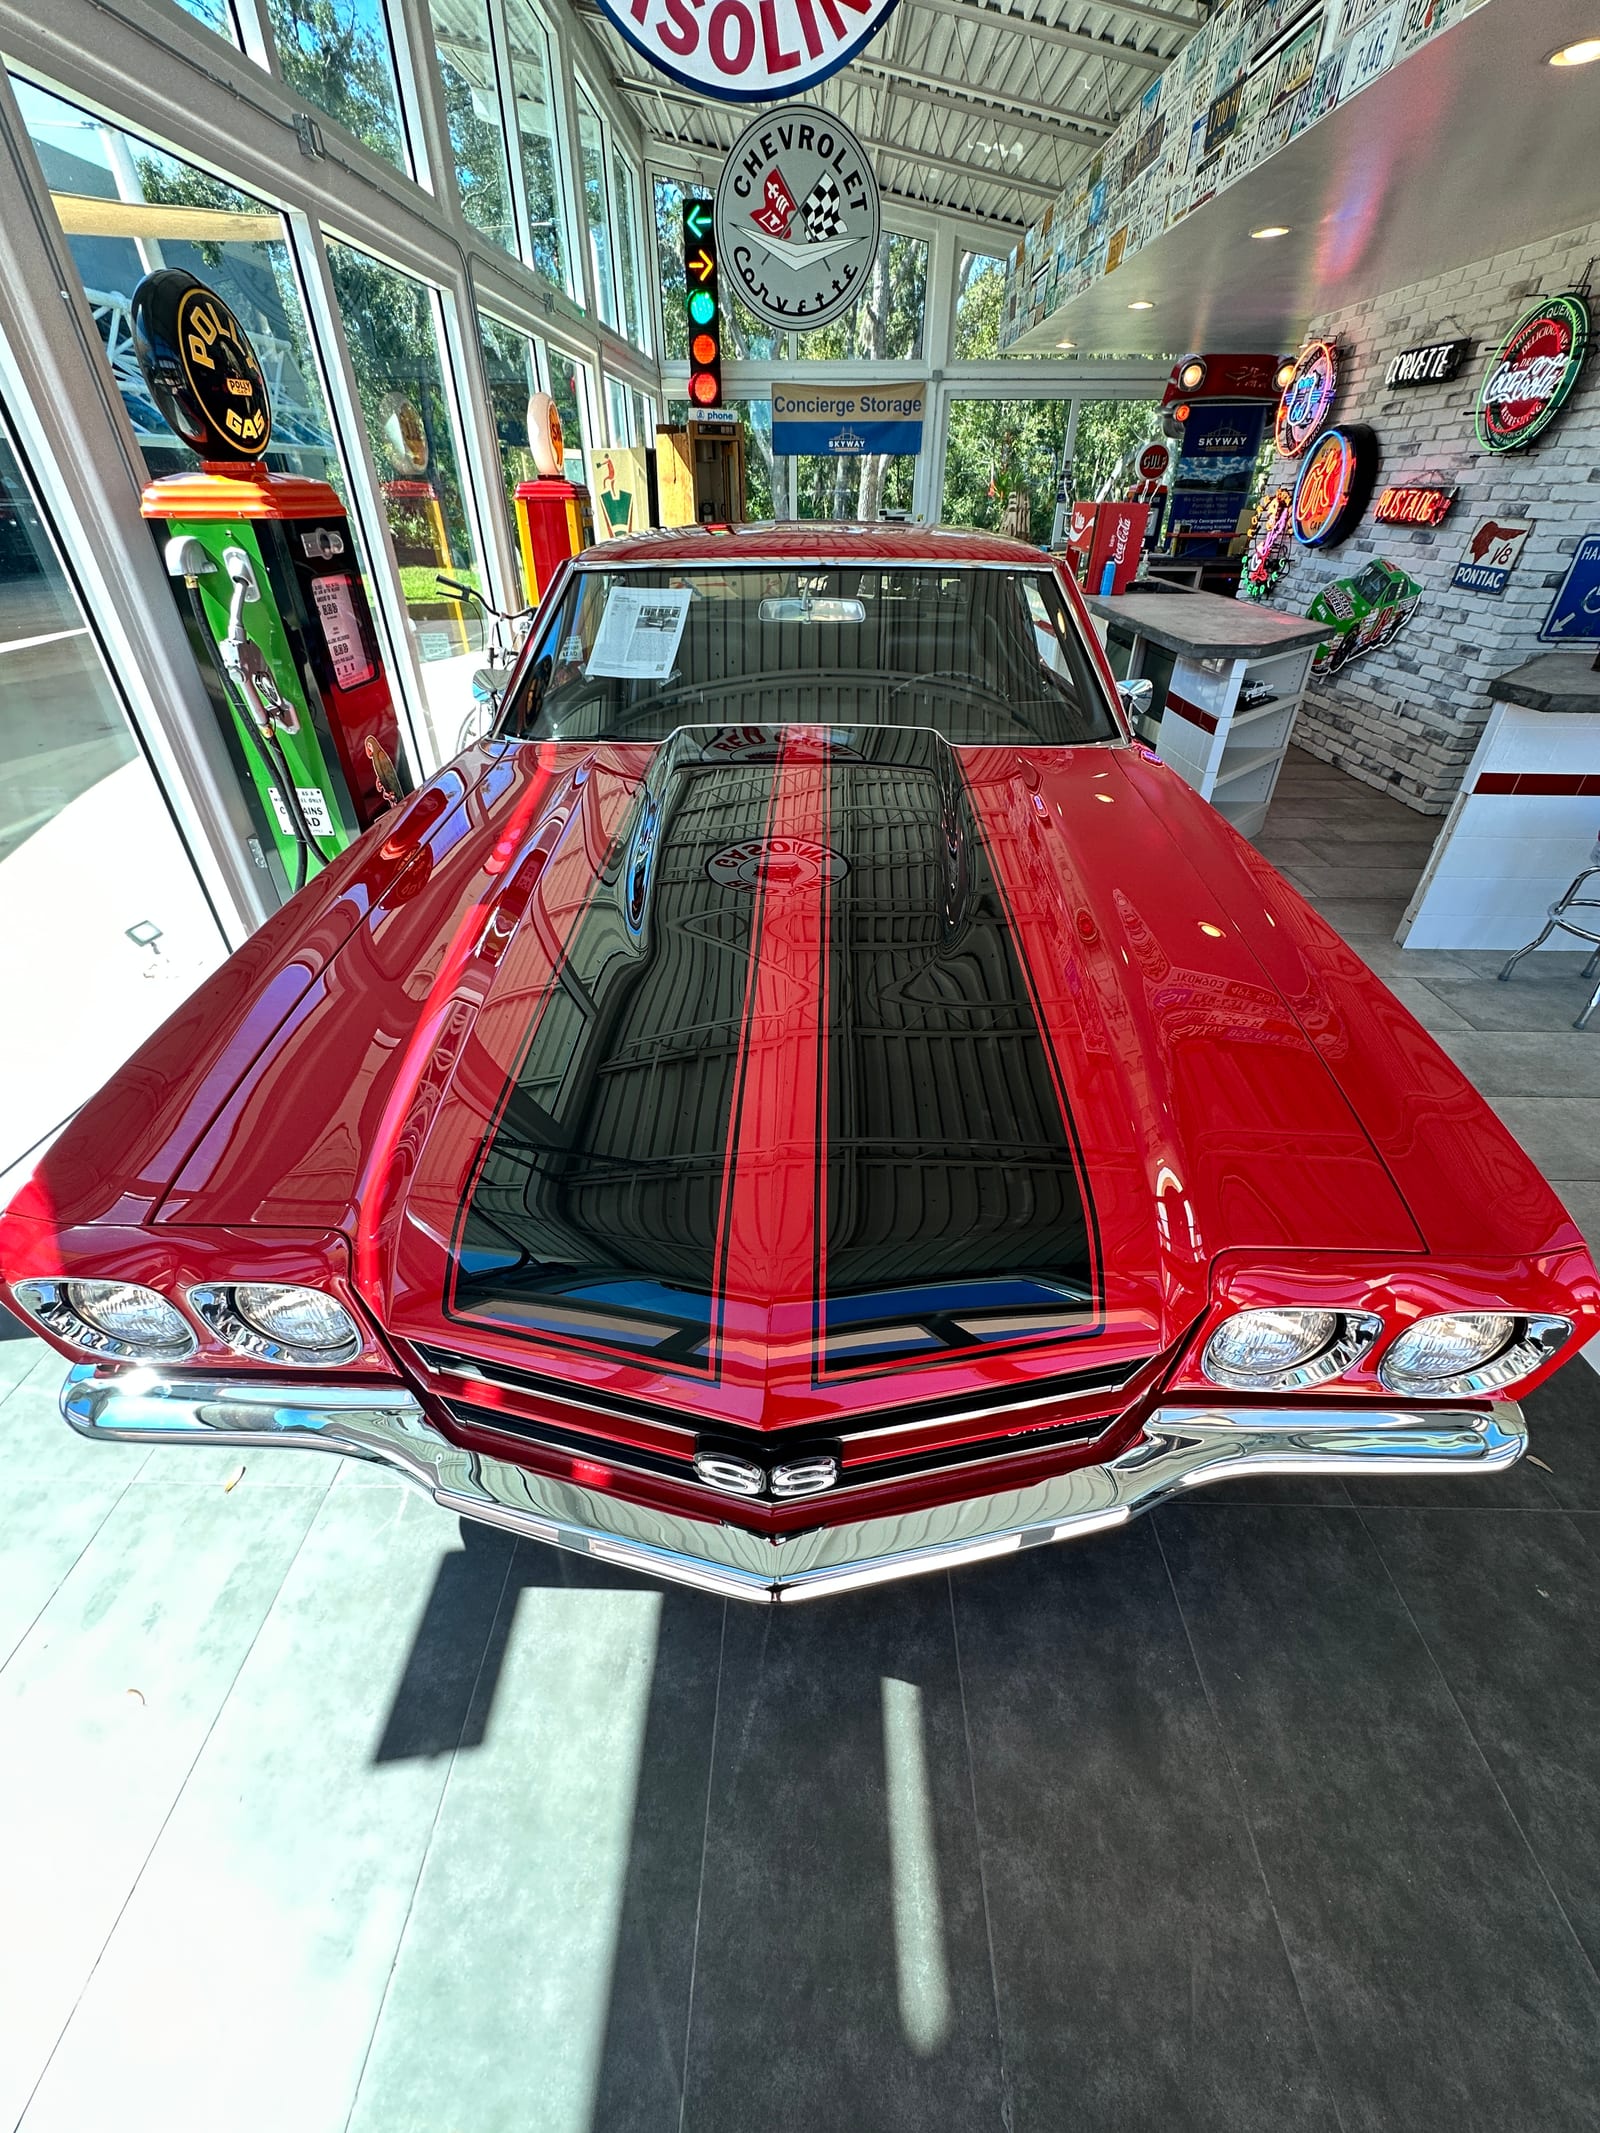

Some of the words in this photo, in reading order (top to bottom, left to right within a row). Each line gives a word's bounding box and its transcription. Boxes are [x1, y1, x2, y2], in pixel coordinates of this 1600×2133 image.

[733, 124, 868, 212] CHEVROLET
[1385, 344, 1454, 385] CORVETTE
[707, 412, 734, 421] phone
[774, 396, 855, 416] Concierge
[860, 396, 922, 416] Storage
[225, 408, 265, 439] GAS
[828, 440, 865, 448] SKYWAY
[1198, 437, 1247, 446] SKYWAY
[1143, 455, 1168, 470] GULF
[1490, 543, 1513, 565] V8
[1581, 546, 1600, 560] HA
[1455, 567, 1505, 589] PONTIAC
[693, 1451, 838, 1497] SS
